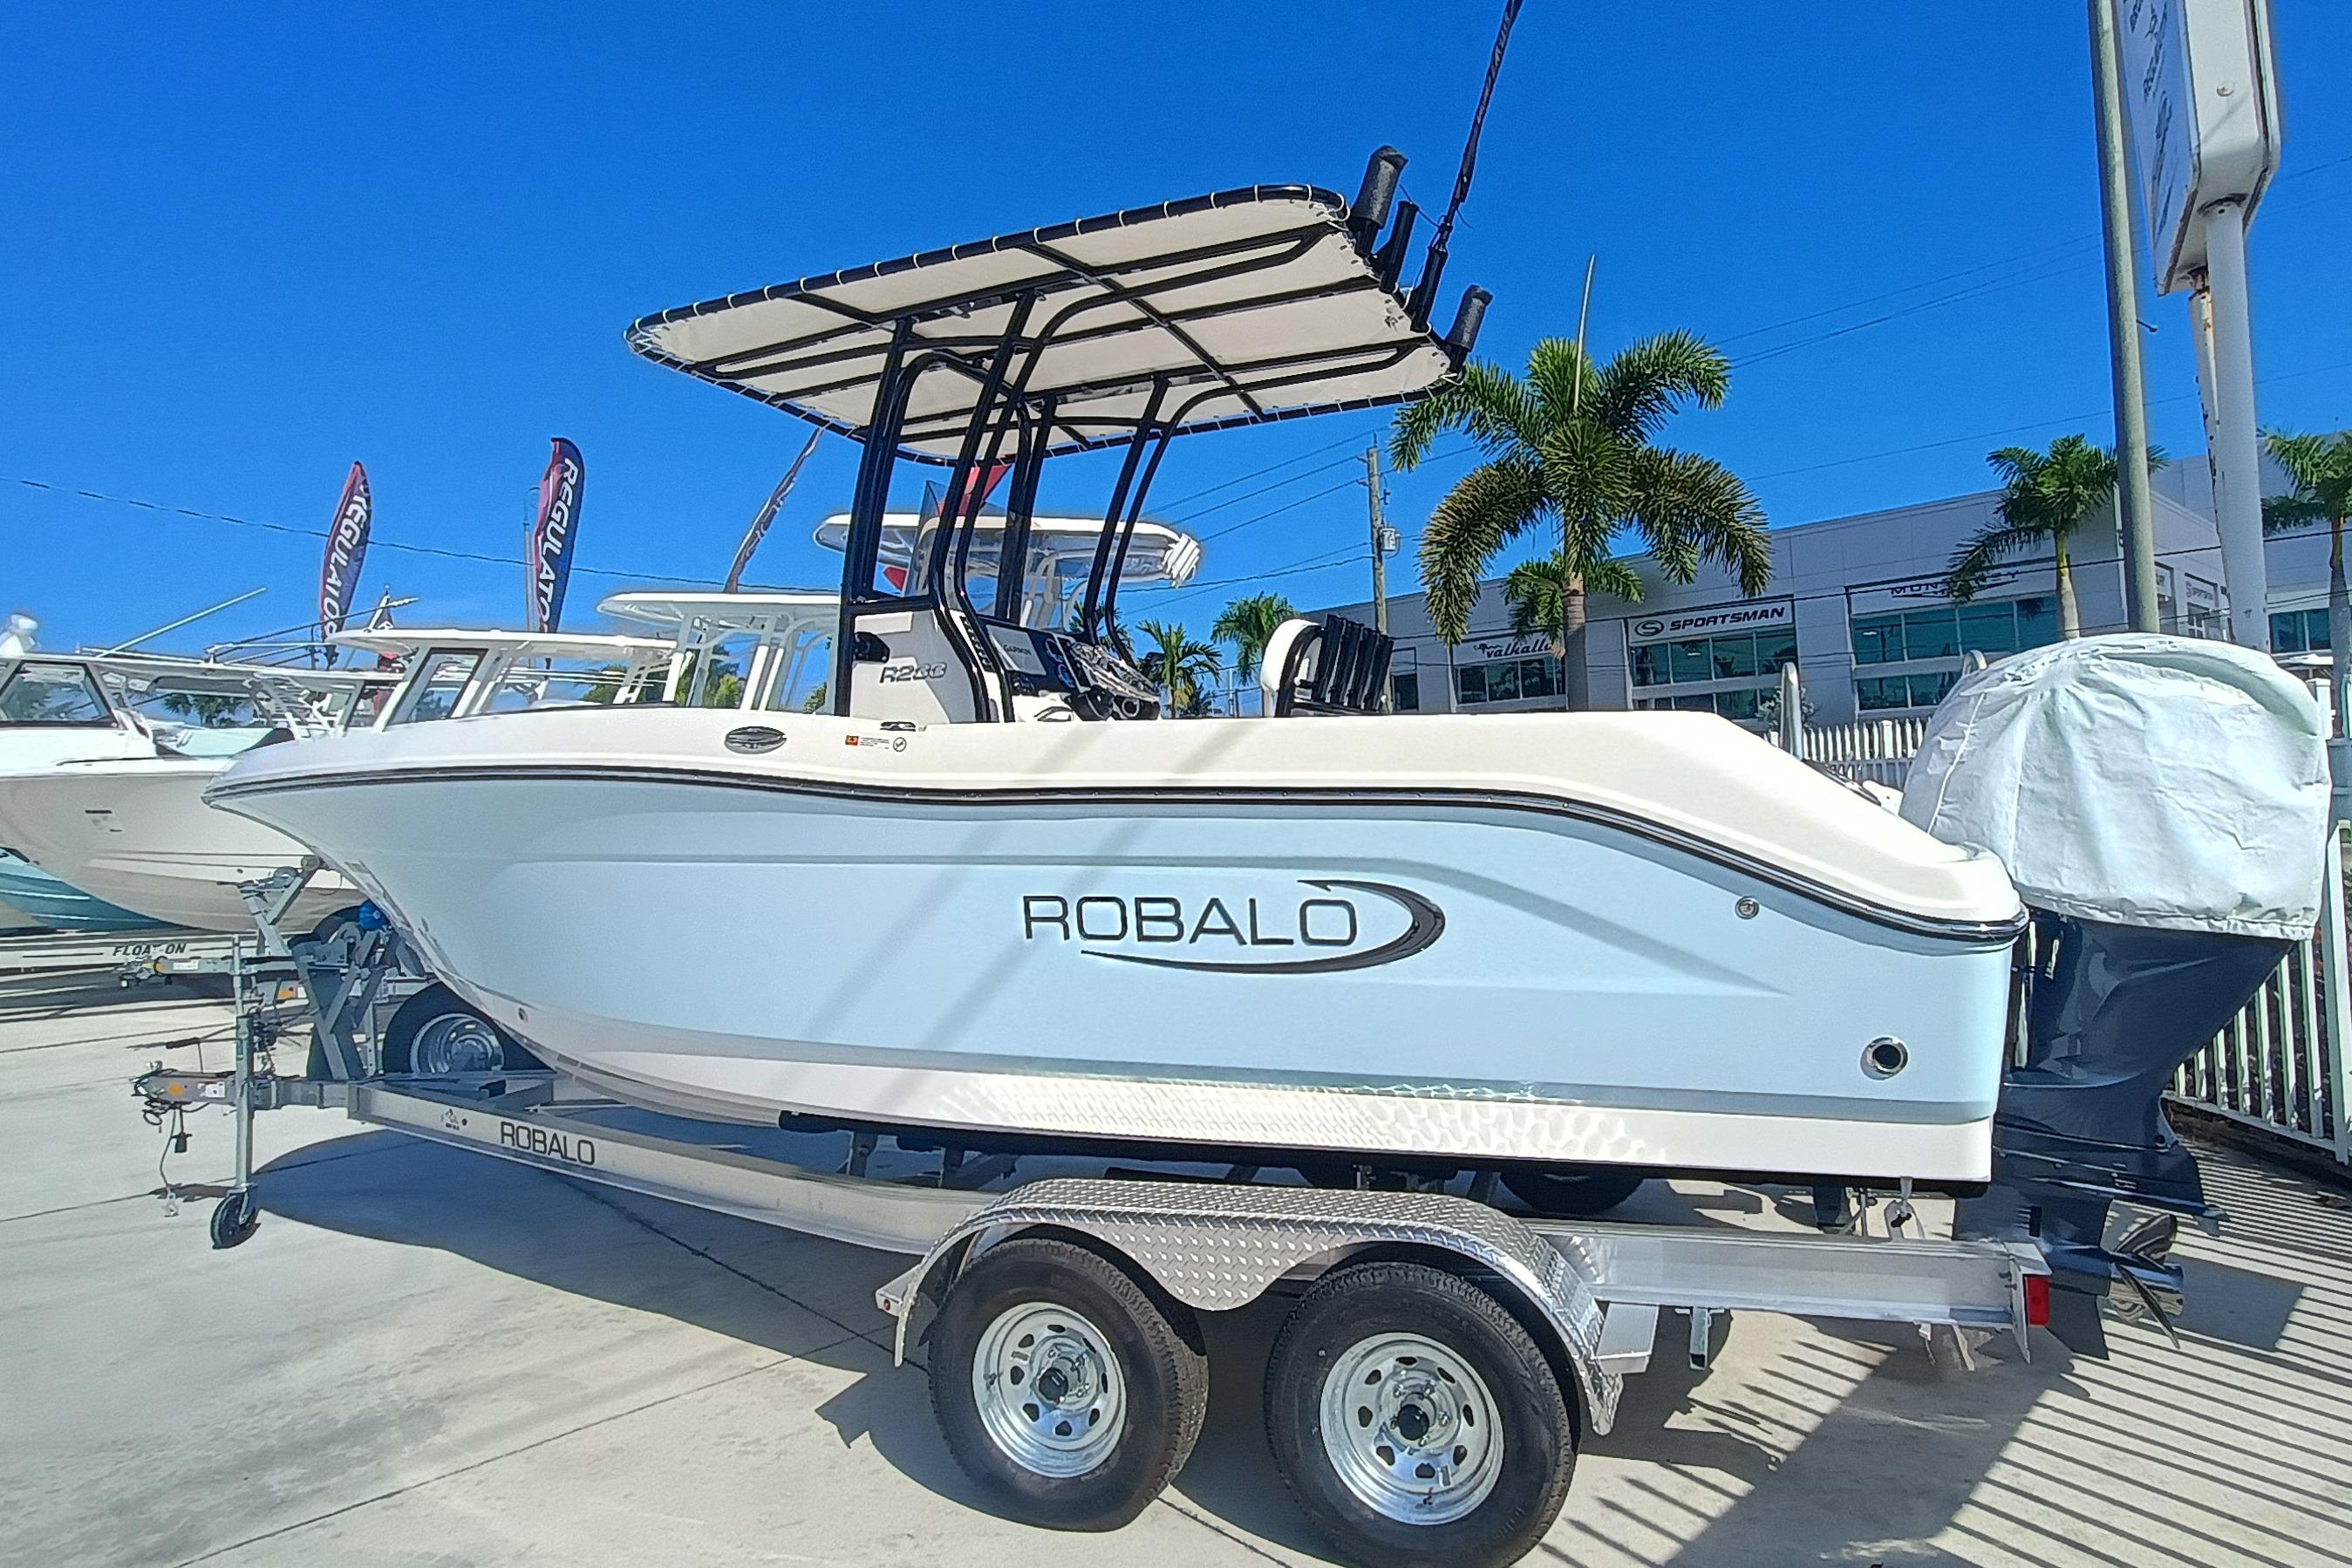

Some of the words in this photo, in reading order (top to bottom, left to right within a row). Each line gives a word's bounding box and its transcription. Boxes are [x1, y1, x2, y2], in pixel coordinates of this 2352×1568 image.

[1669, 607, 1785, 631] SPORTSMAN
[1023, 895, 1358, 946] ROBALO
[501, 1121, 596, 1166] ROBALO
